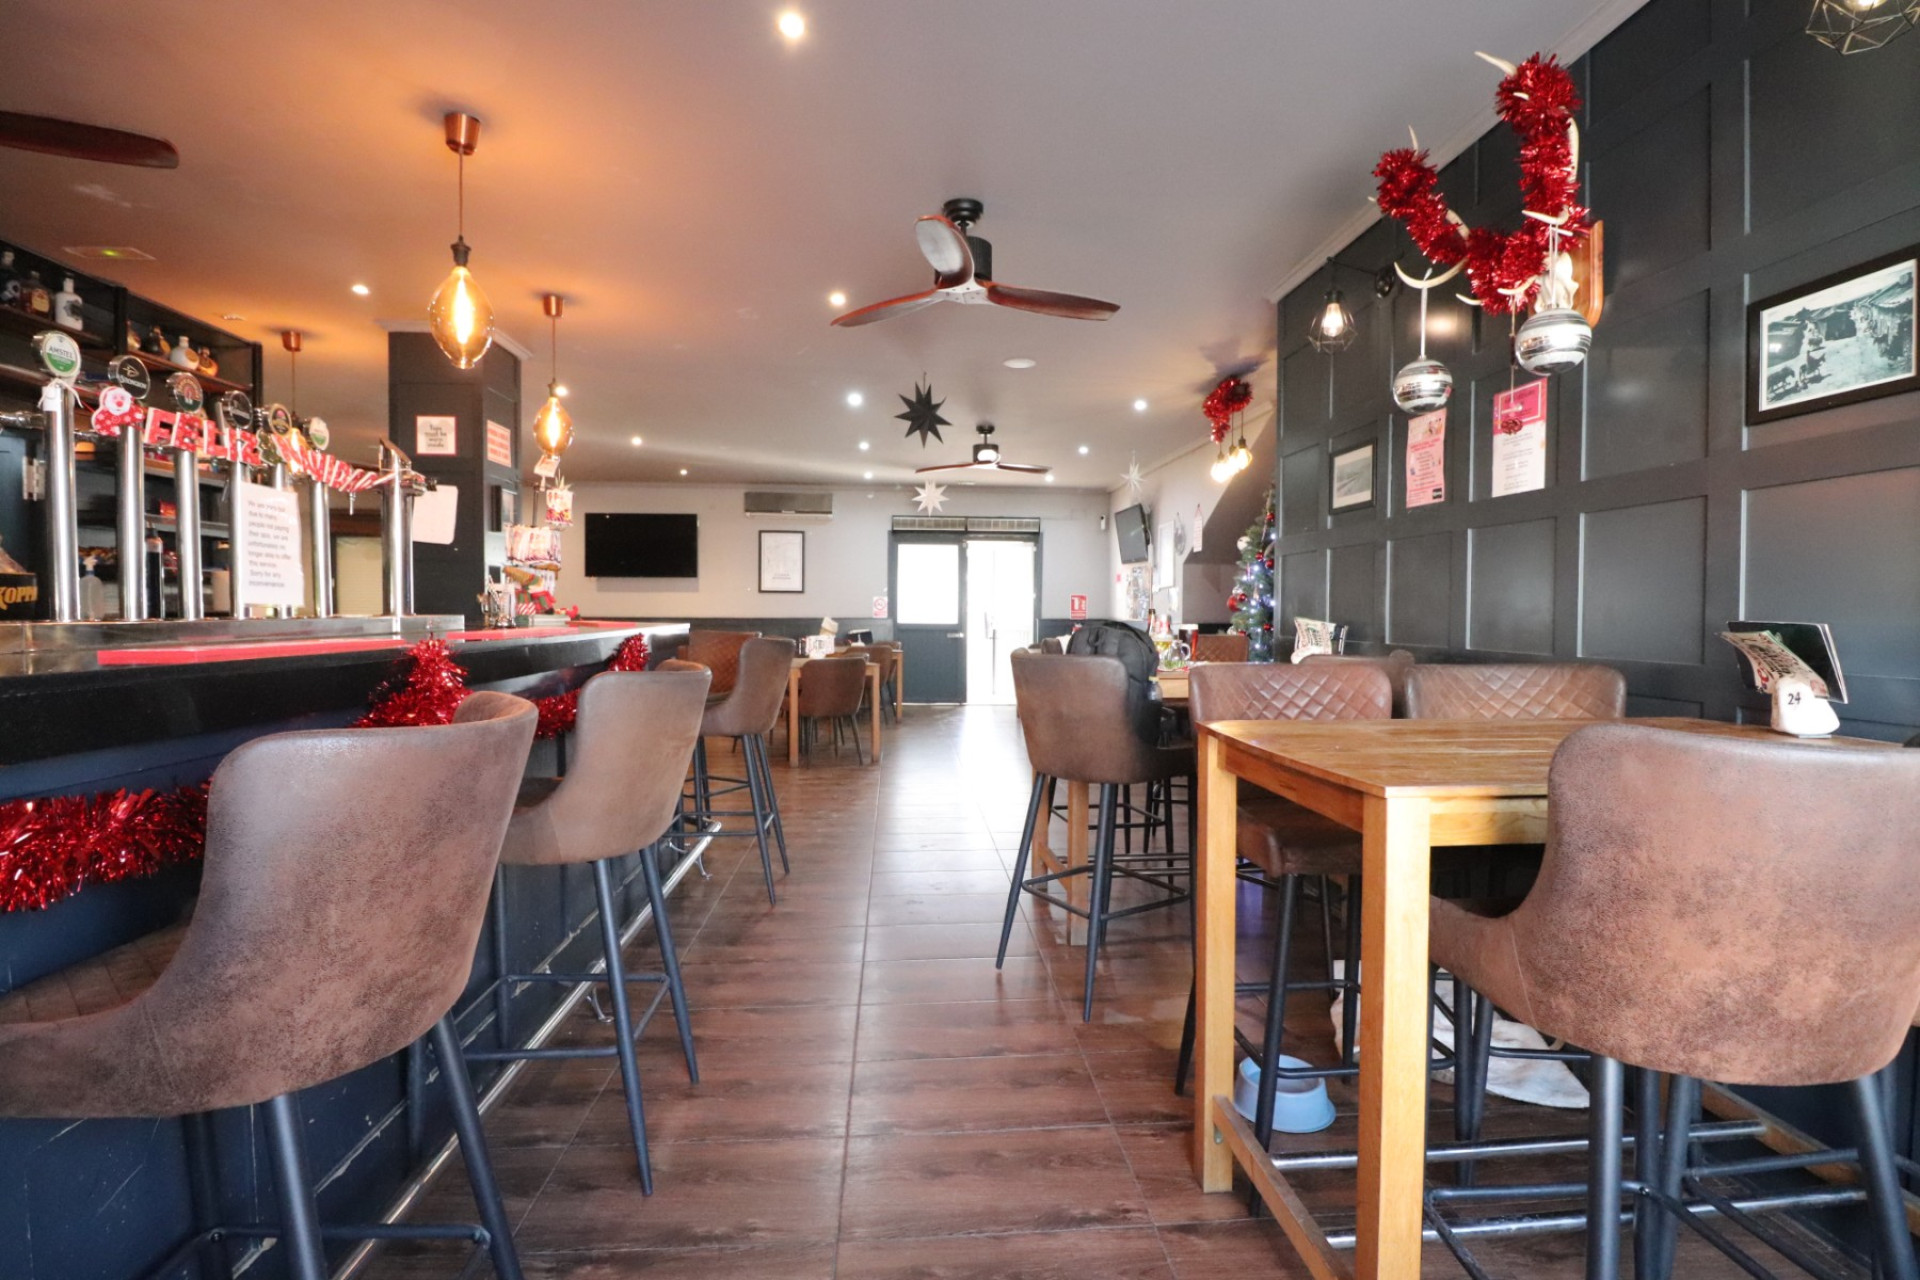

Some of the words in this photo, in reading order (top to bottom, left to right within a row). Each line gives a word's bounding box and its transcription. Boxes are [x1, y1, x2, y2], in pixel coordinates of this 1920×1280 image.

[48, 345, 73, 359] AMSTEL
[144, 406, 262, 466] FELIZ
[1787, 692, 1801, 705] 24
